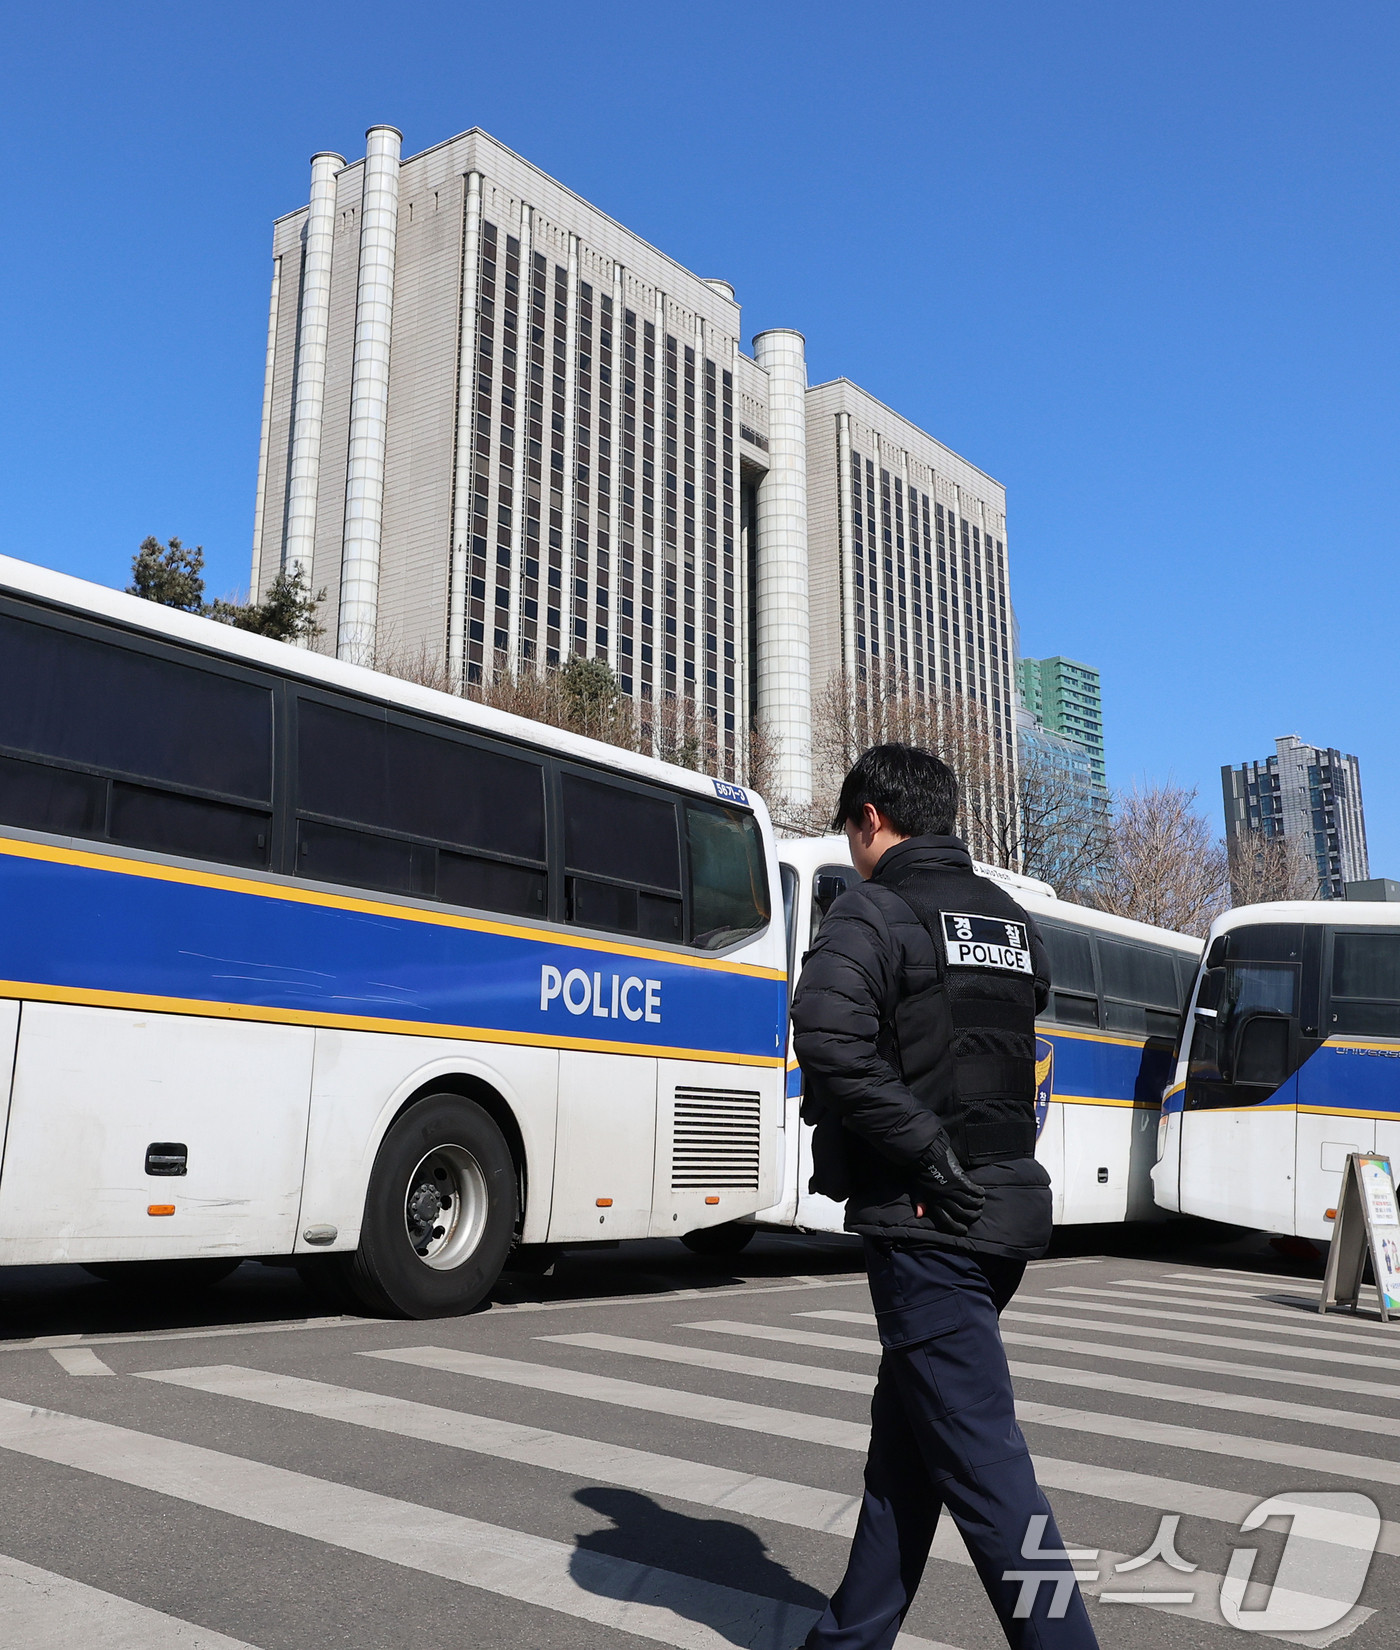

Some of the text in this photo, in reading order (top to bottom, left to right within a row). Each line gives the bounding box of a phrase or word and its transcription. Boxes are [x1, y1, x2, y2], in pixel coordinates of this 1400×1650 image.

[959, 944, 1025, 969] POLICE
[540, 964, 662, 1024] POLICE
[1335, 1046, 1400, 1058] UNIVERS
